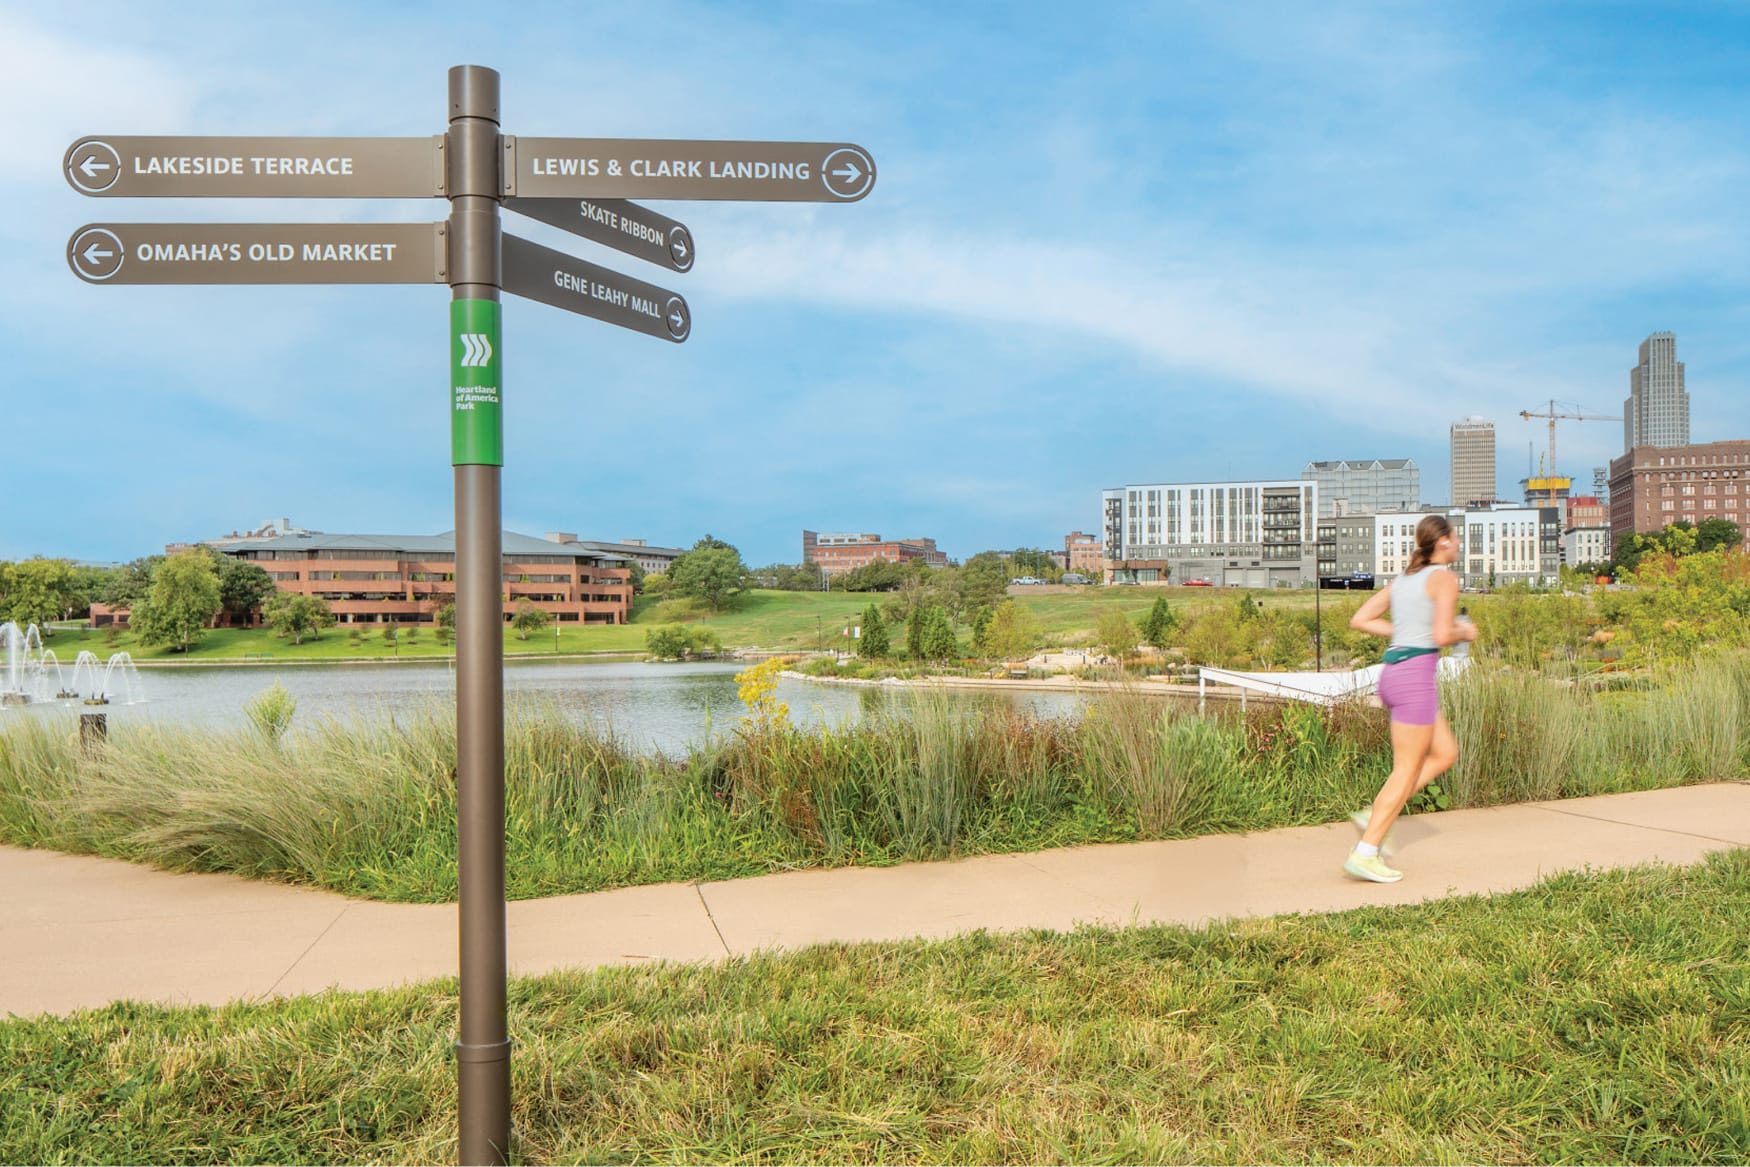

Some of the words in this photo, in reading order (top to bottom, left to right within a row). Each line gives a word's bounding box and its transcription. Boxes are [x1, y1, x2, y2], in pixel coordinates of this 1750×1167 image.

[134, 156, 243, 175] LAKESIDE
[251, 157, 353, 175] TERRACE
[533, 157, 599, 176] LEWIS
[607, 159, 623, 177] &
[630, 159, 702, 178] CLARK
[709, 161, 810, 180] LANDING
[580, 200, 618, 229] SKATE
[621, 216, 664, 247] RIBBON
[137, 243, 241, 262] OMAHA'S
[248, 243, 294, 262] OLD
[302, 243, 397, 261] MARKET
[554, 270, 588, 294] GENE
[591, 281, 629, 307] LEAHY
[631, 295, 661, 318] MALL
[455, 385, 496, 393] Heartland
[455, 394, 464, 402] of
[465, 394, 499, 403] America
[455, 402, 474, 410] Park
